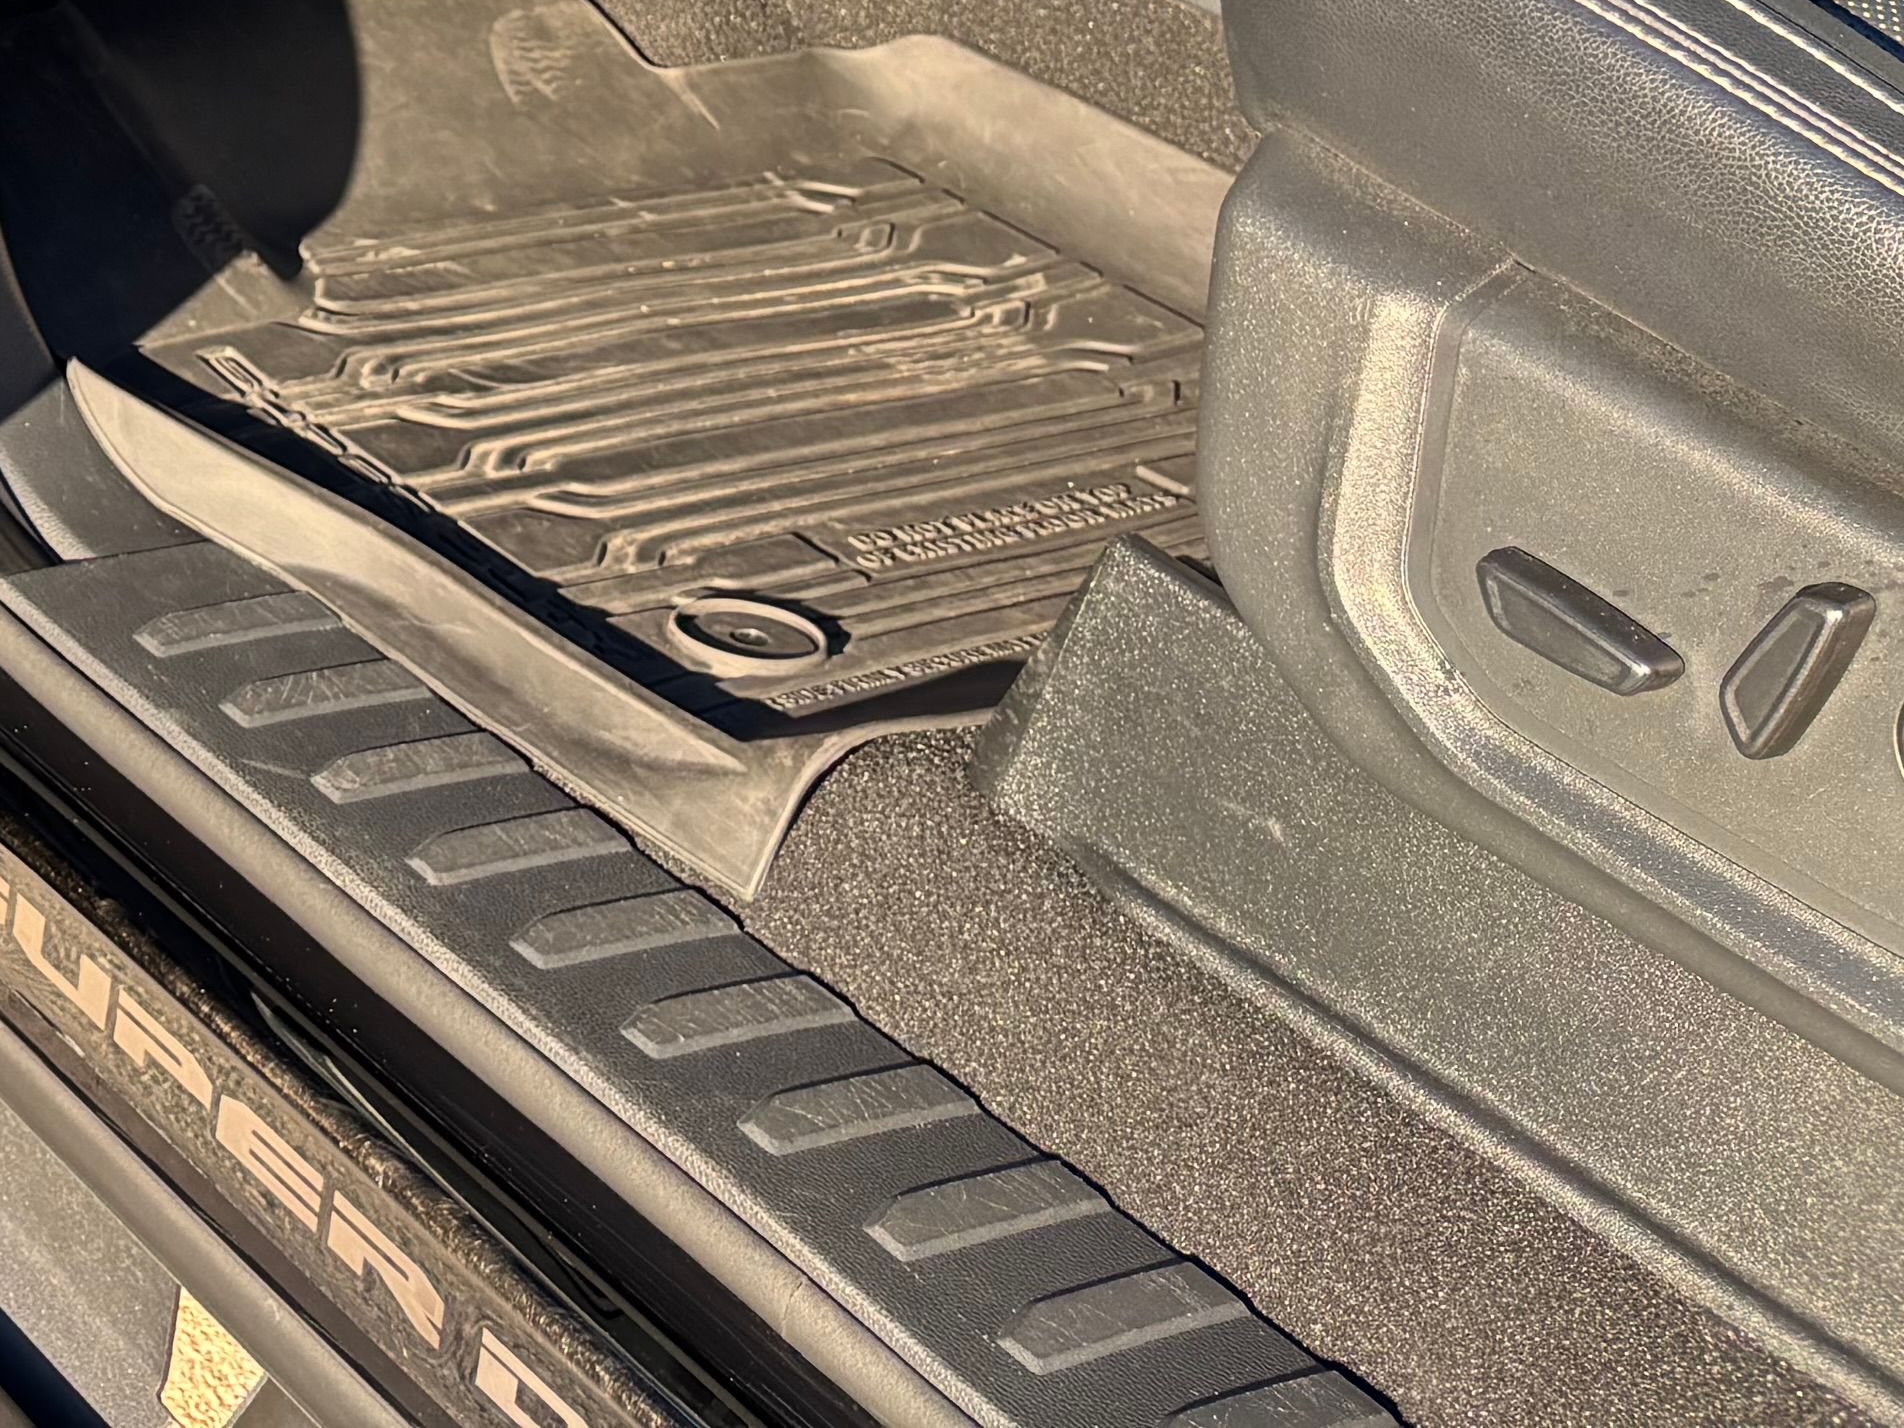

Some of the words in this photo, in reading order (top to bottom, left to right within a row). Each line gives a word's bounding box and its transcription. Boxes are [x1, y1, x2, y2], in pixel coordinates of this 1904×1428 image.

[848, 530, 895, 552] DO
[892, 520, 954, 543] NOT
[951, 504, 1039, 532] PLACE
[1034, 494, 1081, 516] ON
[857, 548, 895, 570] OF
